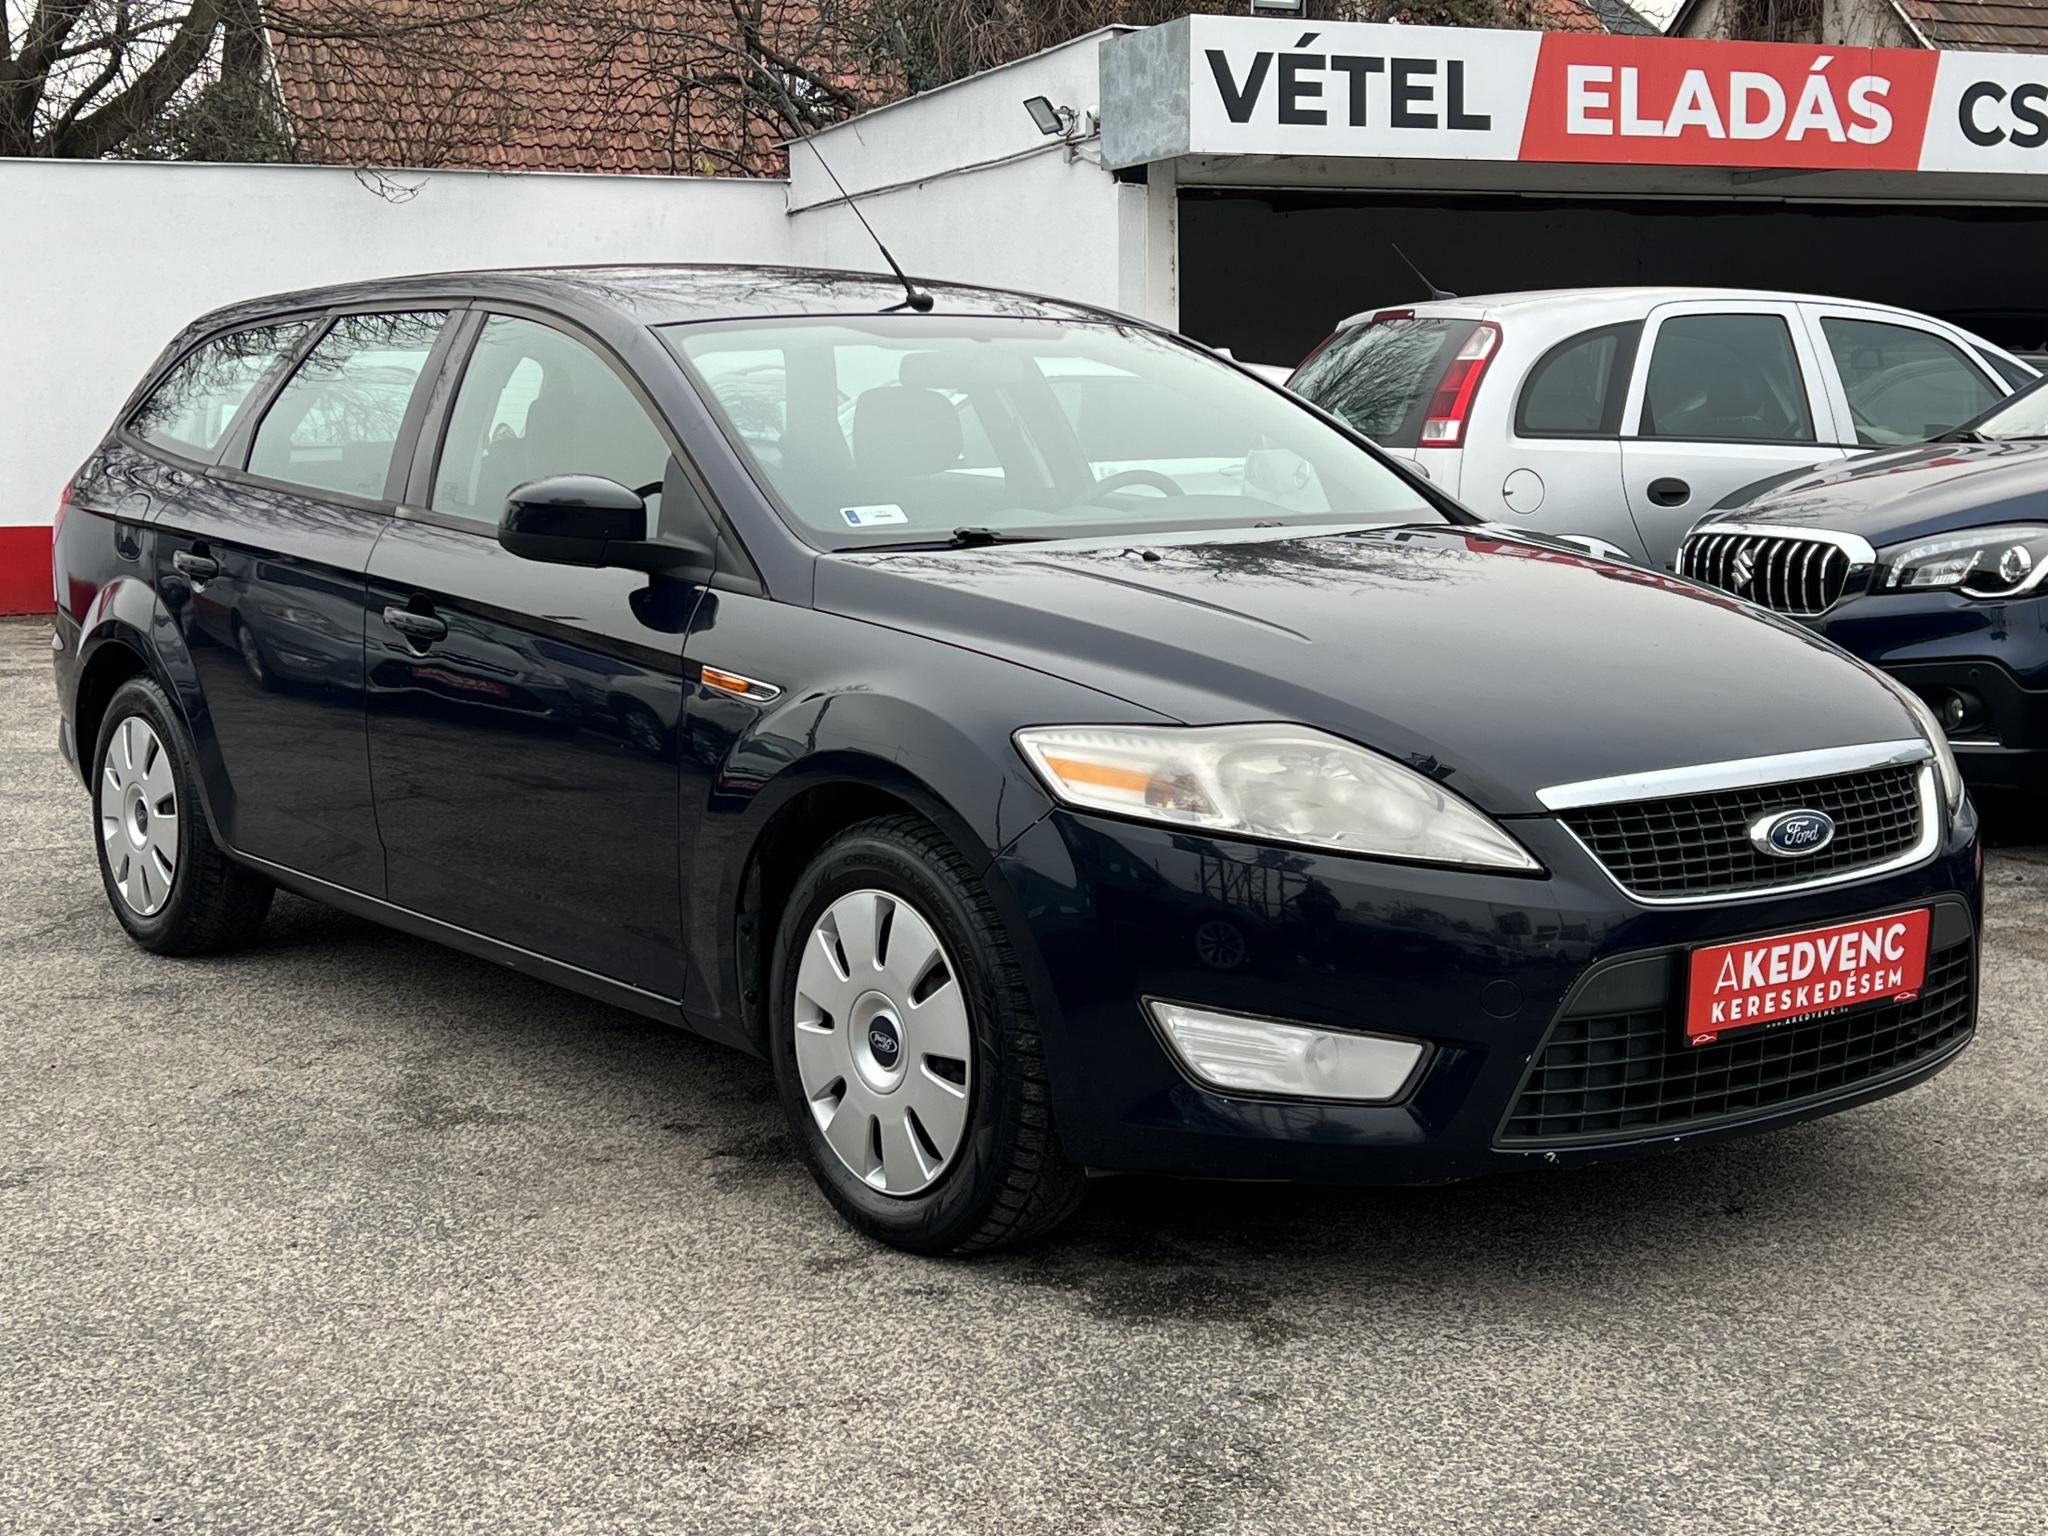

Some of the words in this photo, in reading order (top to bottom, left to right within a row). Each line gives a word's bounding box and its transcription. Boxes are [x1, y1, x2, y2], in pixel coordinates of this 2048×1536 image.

[1203, 32, 1492, 131] VÉTEL
[1566, 55, 1893, 143] ELADÁS
[1784, 820, 1819, 845] Ford
[1711, 966, 1902, 1024] KERESKEDÉSEM
